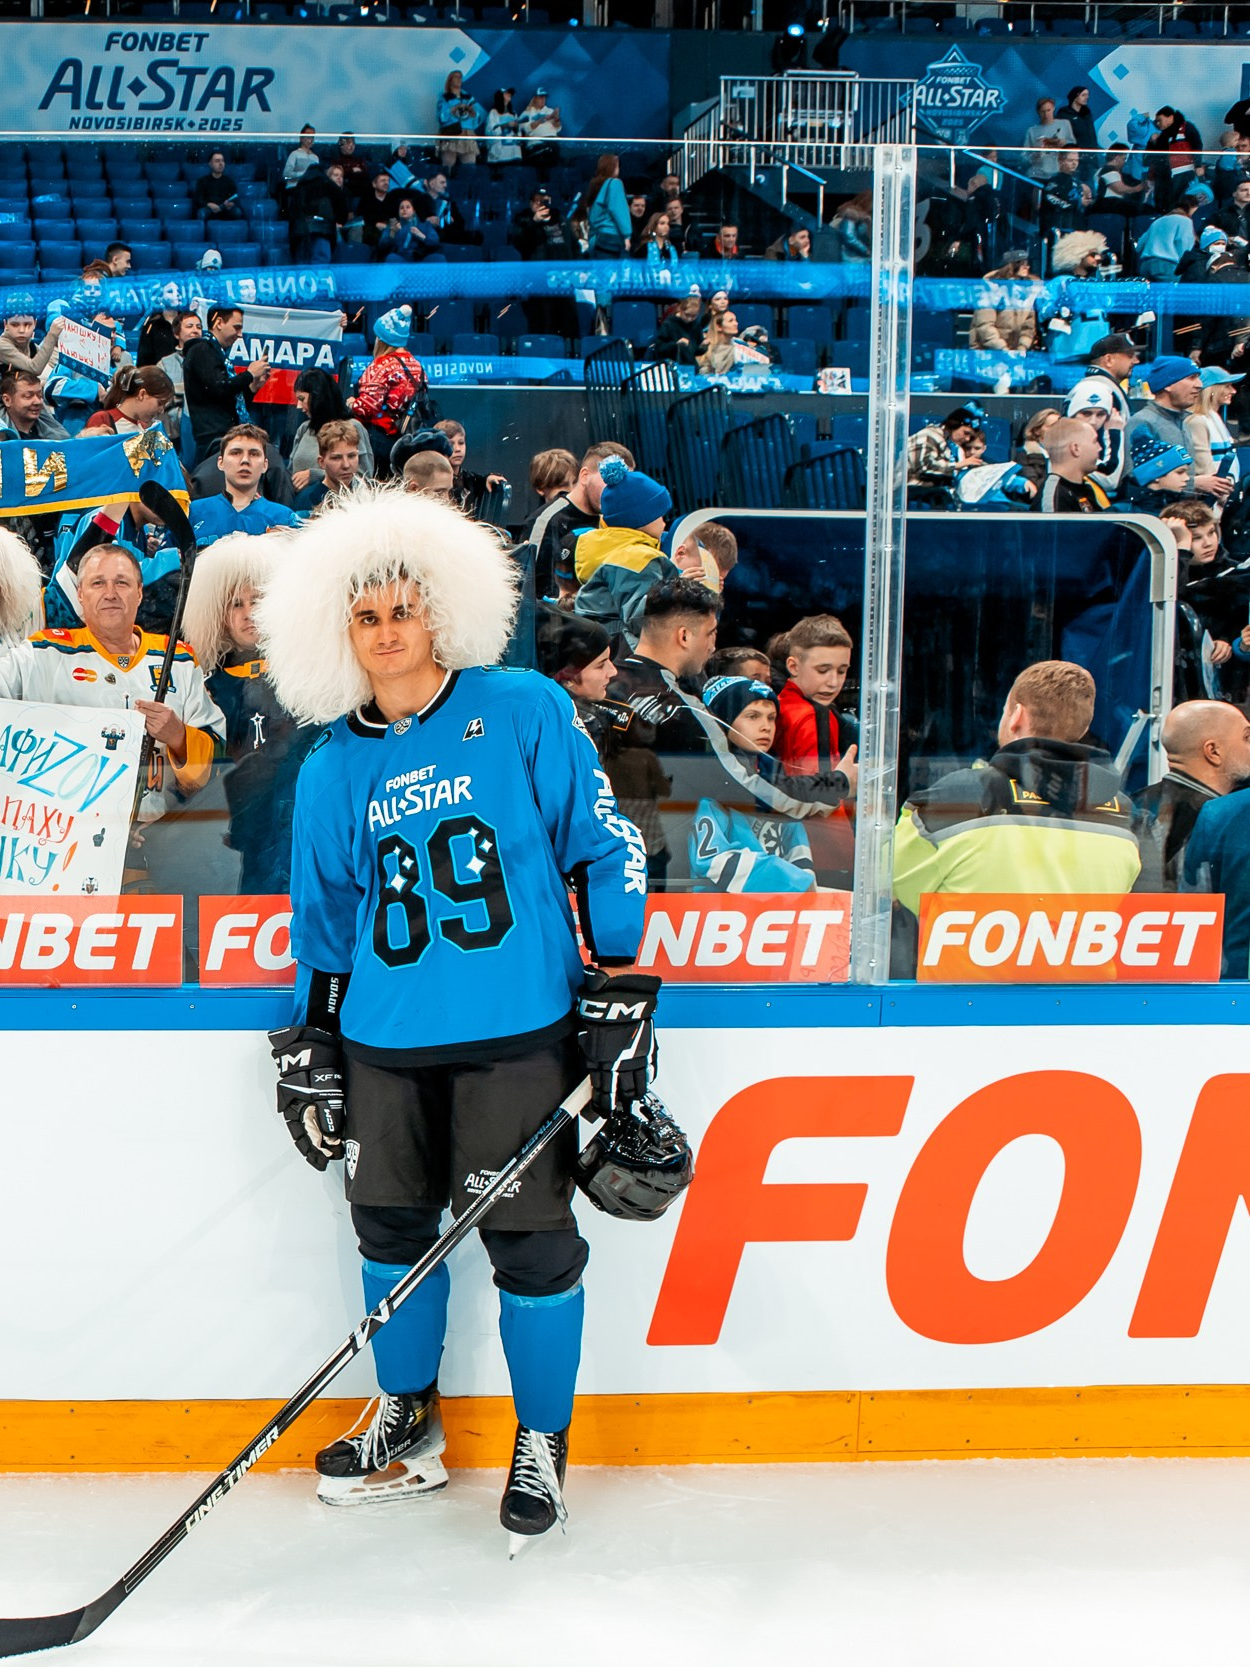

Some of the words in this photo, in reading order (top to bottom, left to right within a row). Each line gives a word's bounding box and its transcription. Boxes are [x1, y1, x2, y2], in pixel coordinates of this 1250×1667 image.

[104, 31, 210, 53] FONBET
[137, 57, 276, 113] STAR
[936, 76, 972, 84] FONBET
[69, 116, 187, 131] NOVOSIBIRSK
[198, 117, 244, 132] 2025
[228, 337, 336, 369] АМАРА
[386, 765, 437, 793] FONBET
[404, 775, 473, 816] STAR
[372, 811, 518, 972] 89
[639, 910, 847, 968] NBET
[922, 910, 1218, 967] FONBET
[579, 999, 648, 1020] CM
[377, 1438, 411, 1465] BUER
[182, 1481, 225, 1534] ONE
[220, 1424, 282, 1487] TIMER
